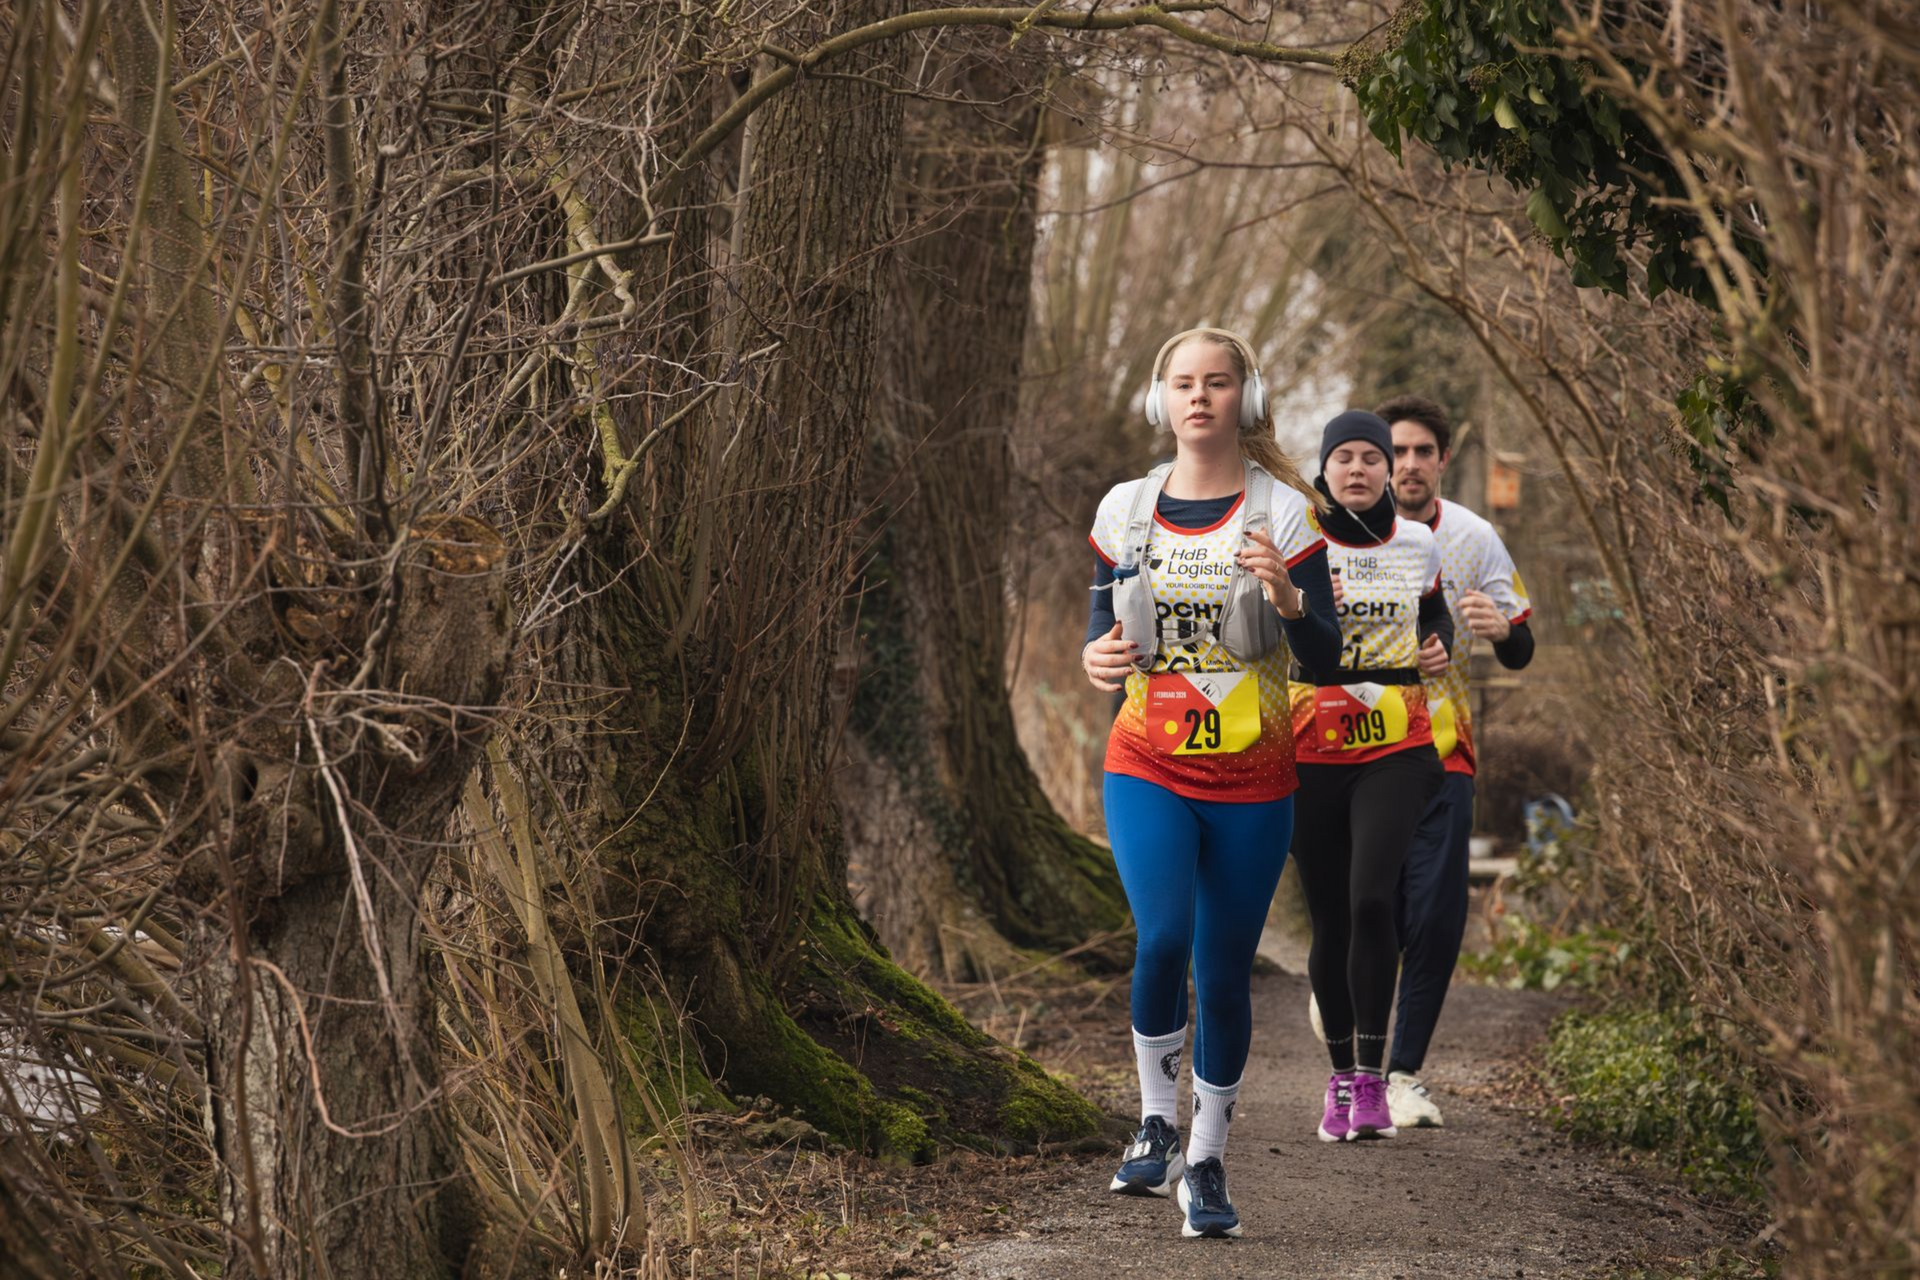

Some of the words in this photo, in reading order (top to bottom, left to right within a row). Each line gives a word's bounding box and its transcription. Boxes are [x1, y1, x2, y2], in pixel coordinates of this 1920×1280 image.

[1170, 548, 1208, 561] HdB
[1347, 556, 1378, 569] HdB
[1167, 561, 1233, 579] Logistic
[1155, 601, 1224, 620] OCHT
[1336, 601, 1400, 617] OCHT
[1184, 708, 1221, 750] 29
[1340, 709, 1386, 746] 309
